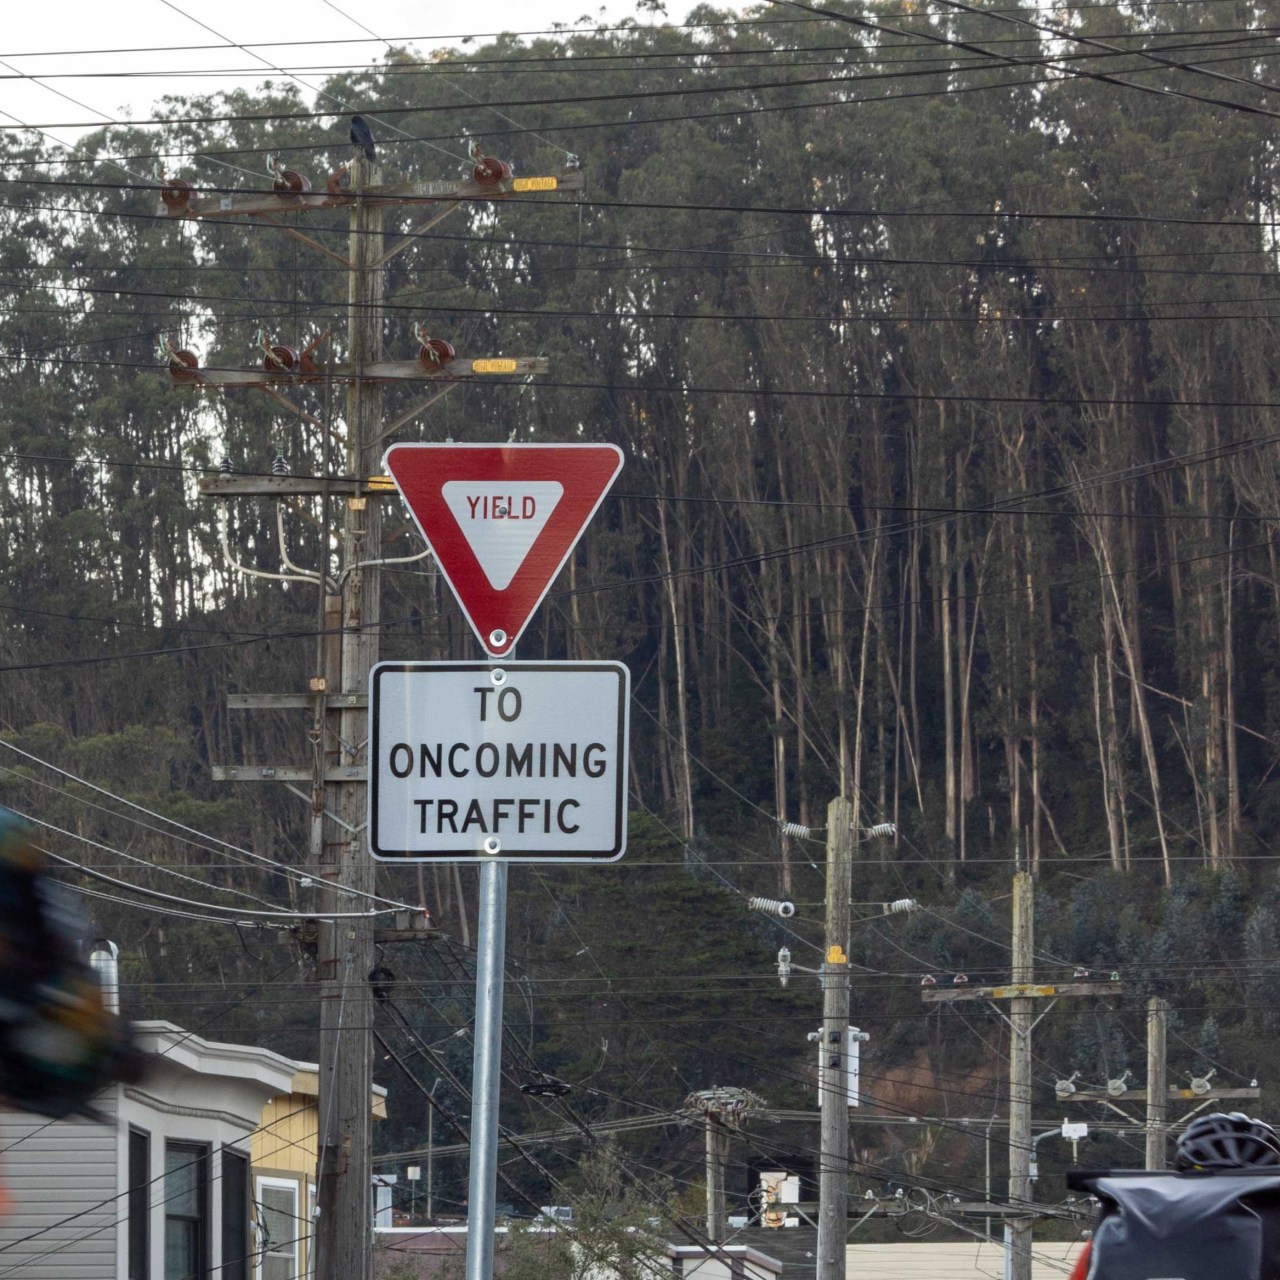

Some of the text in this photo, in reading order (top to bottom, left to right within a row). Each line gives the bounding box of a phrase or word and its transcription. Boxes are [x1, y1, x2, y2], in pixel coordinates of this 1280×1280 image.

[466, 495, 537, 520] YIELD
[473, 686, 523, 722] TO
[388, 742, 608, 779] ONCOMING
[413, 798, 581, 835] TRAFFIC
